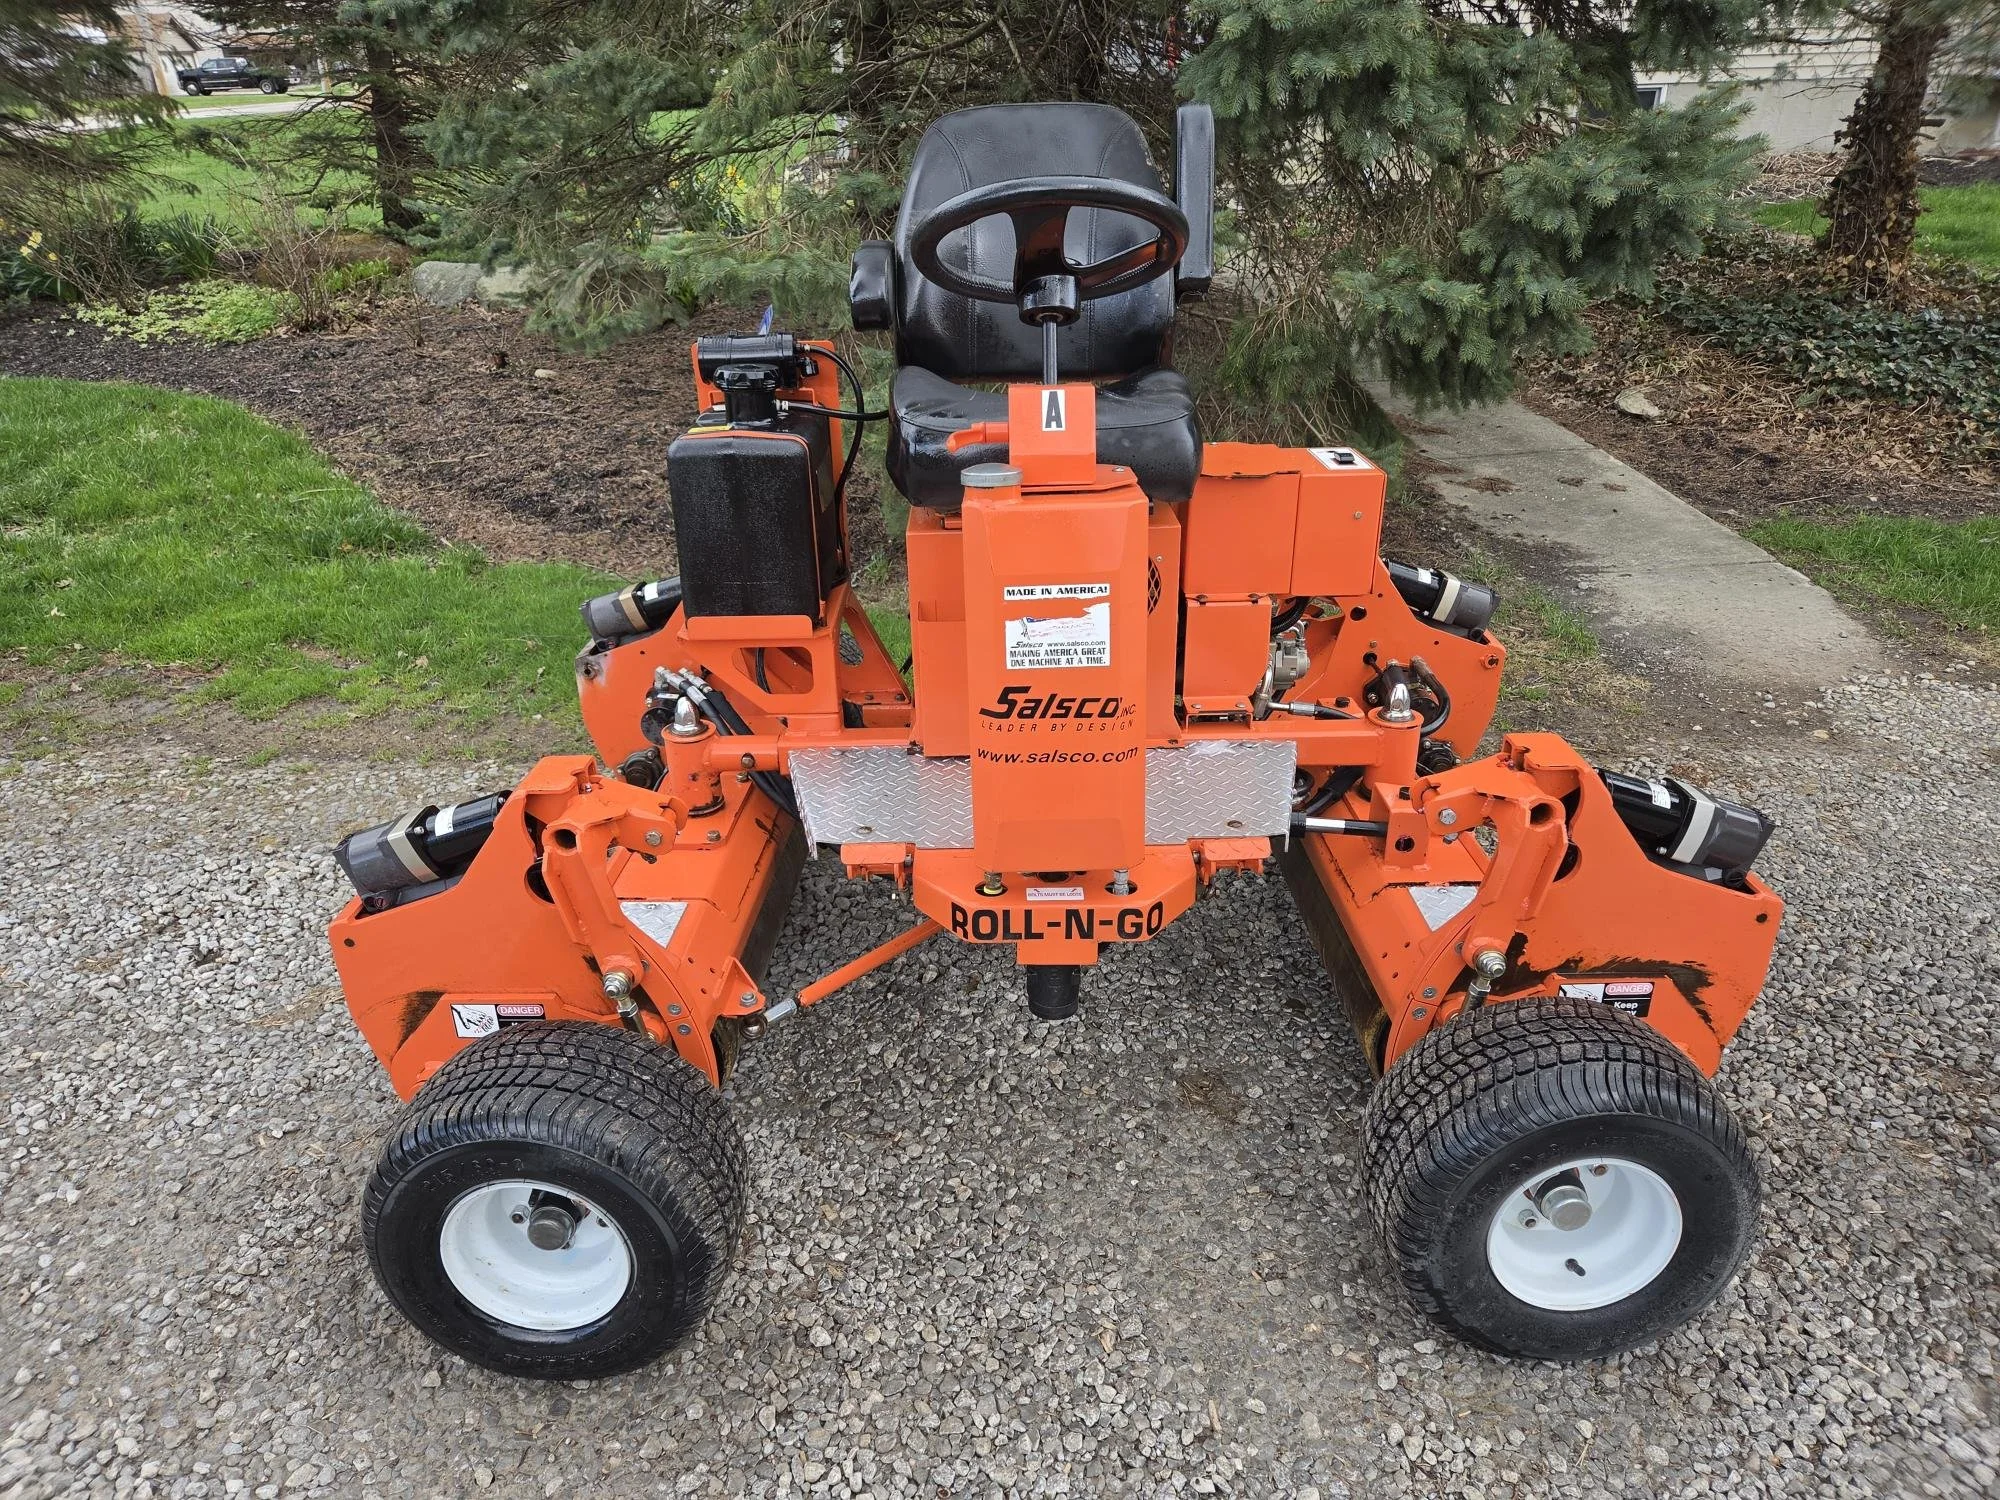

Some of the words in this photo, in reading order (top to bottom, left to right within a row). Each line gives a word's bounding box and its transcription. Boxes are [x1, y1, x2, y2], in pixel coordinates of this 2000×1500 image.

[1045, 391, 1063, 429] A
[1006, 588, 1036, 597] MADE
[1041, 587, 1052, 596] IN
[1056, 586, 1108, 595] AMERICA!
[1010, 641, 1044, 649] Salsco
[1047, 640, 1106, 648] www.salsco.com
[1010, 649, 1041, 658] MAKING
[1044, 648, 1078, 657] AMERICA
[1081, 647, 1106, 656] GREAT
[1010, 658, 1026, 667] ONE
[1028, 657, 1062, 667] MACHINE
[1065, 657, 1074, 665] AT
[1077, 657, 1083, 665] A
[1086, 656, 1106, 665] TIME.
[981, 720, 1037, 732] LEADER
[1051, 723, 1068, 732] BY
[1076, 720, 1134, 732] DESIGN
[977, 747, 1138, 763] www.salsco.com
[951, 901, 1163, 940] ROLL-N-GO
[1609, 985, 1650, 993] DANGER
[500, 1006, 541, 1014] DANGER
[1614, 1001, 1638, 1010] Keep
